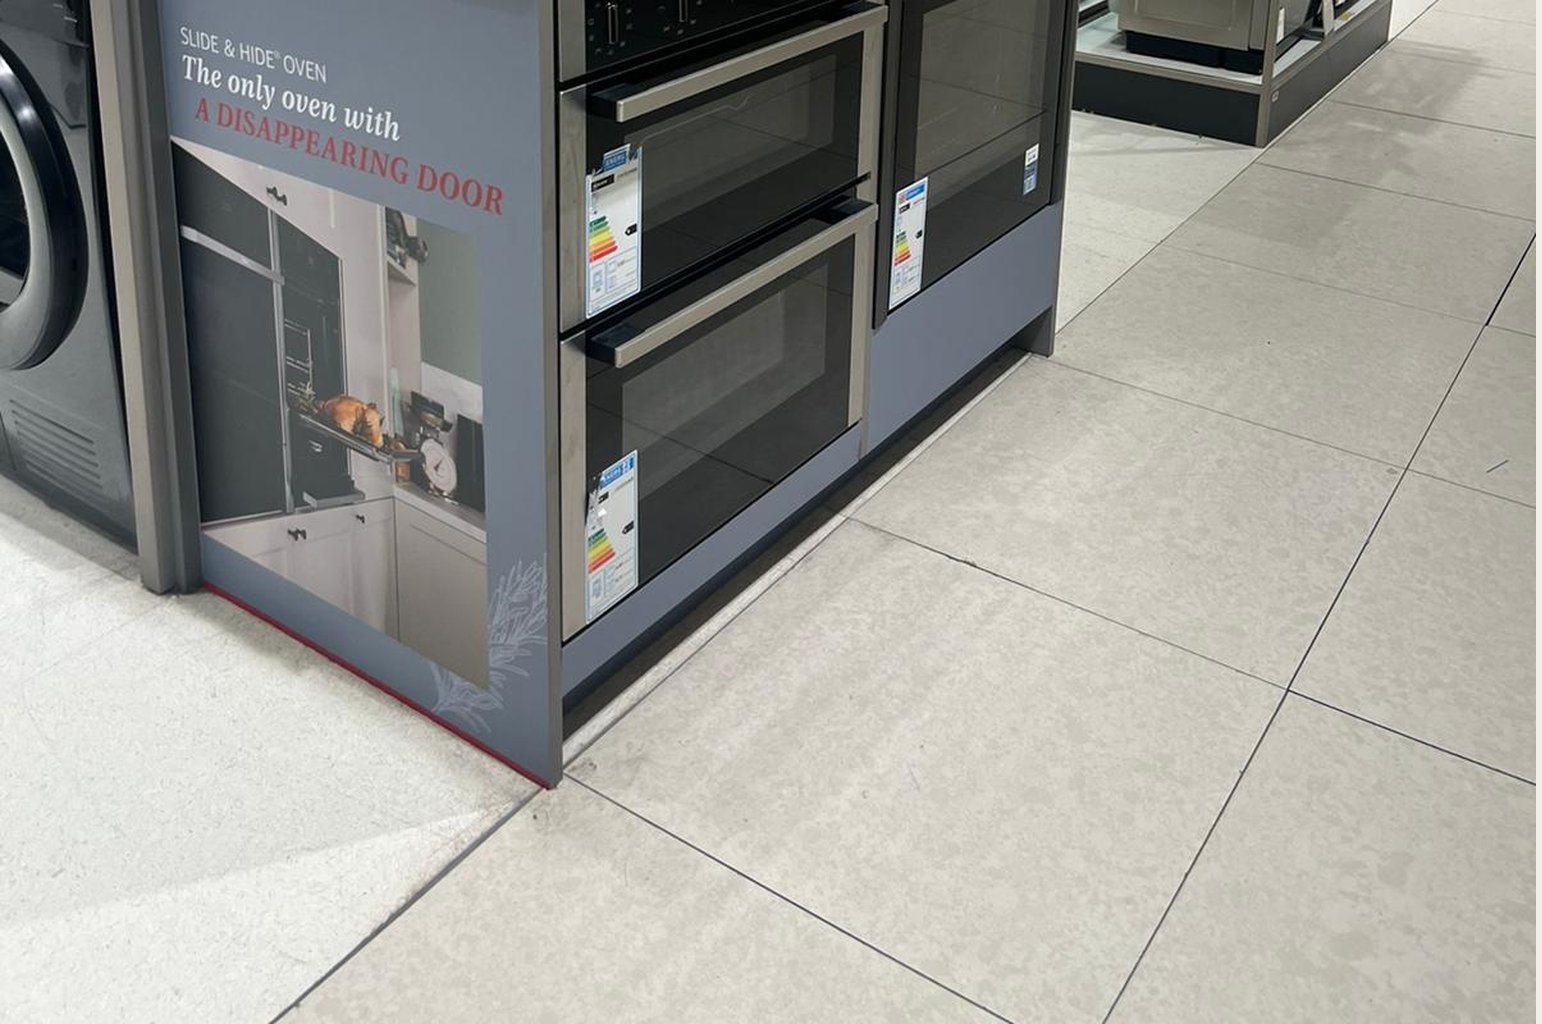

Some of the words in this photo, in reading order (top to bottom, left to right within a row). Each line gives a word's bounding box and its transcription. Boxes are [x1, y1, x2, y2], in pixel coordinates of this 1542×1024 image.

[180, 26, 219, 54] SLIDE
[224, 38, 236, 58] &
[283, 54, 327, 83] OVEN
[182, 55, 222, 89] The
[228, 73, 275, 110] only
[281, 90, 337, 123] oven
[344, 106, 400, 142] with
[194, 98, 210, 123] A
[217, 101, 409, 185] DISAPPEARING
[416, 163, 504, 215] DOOR
